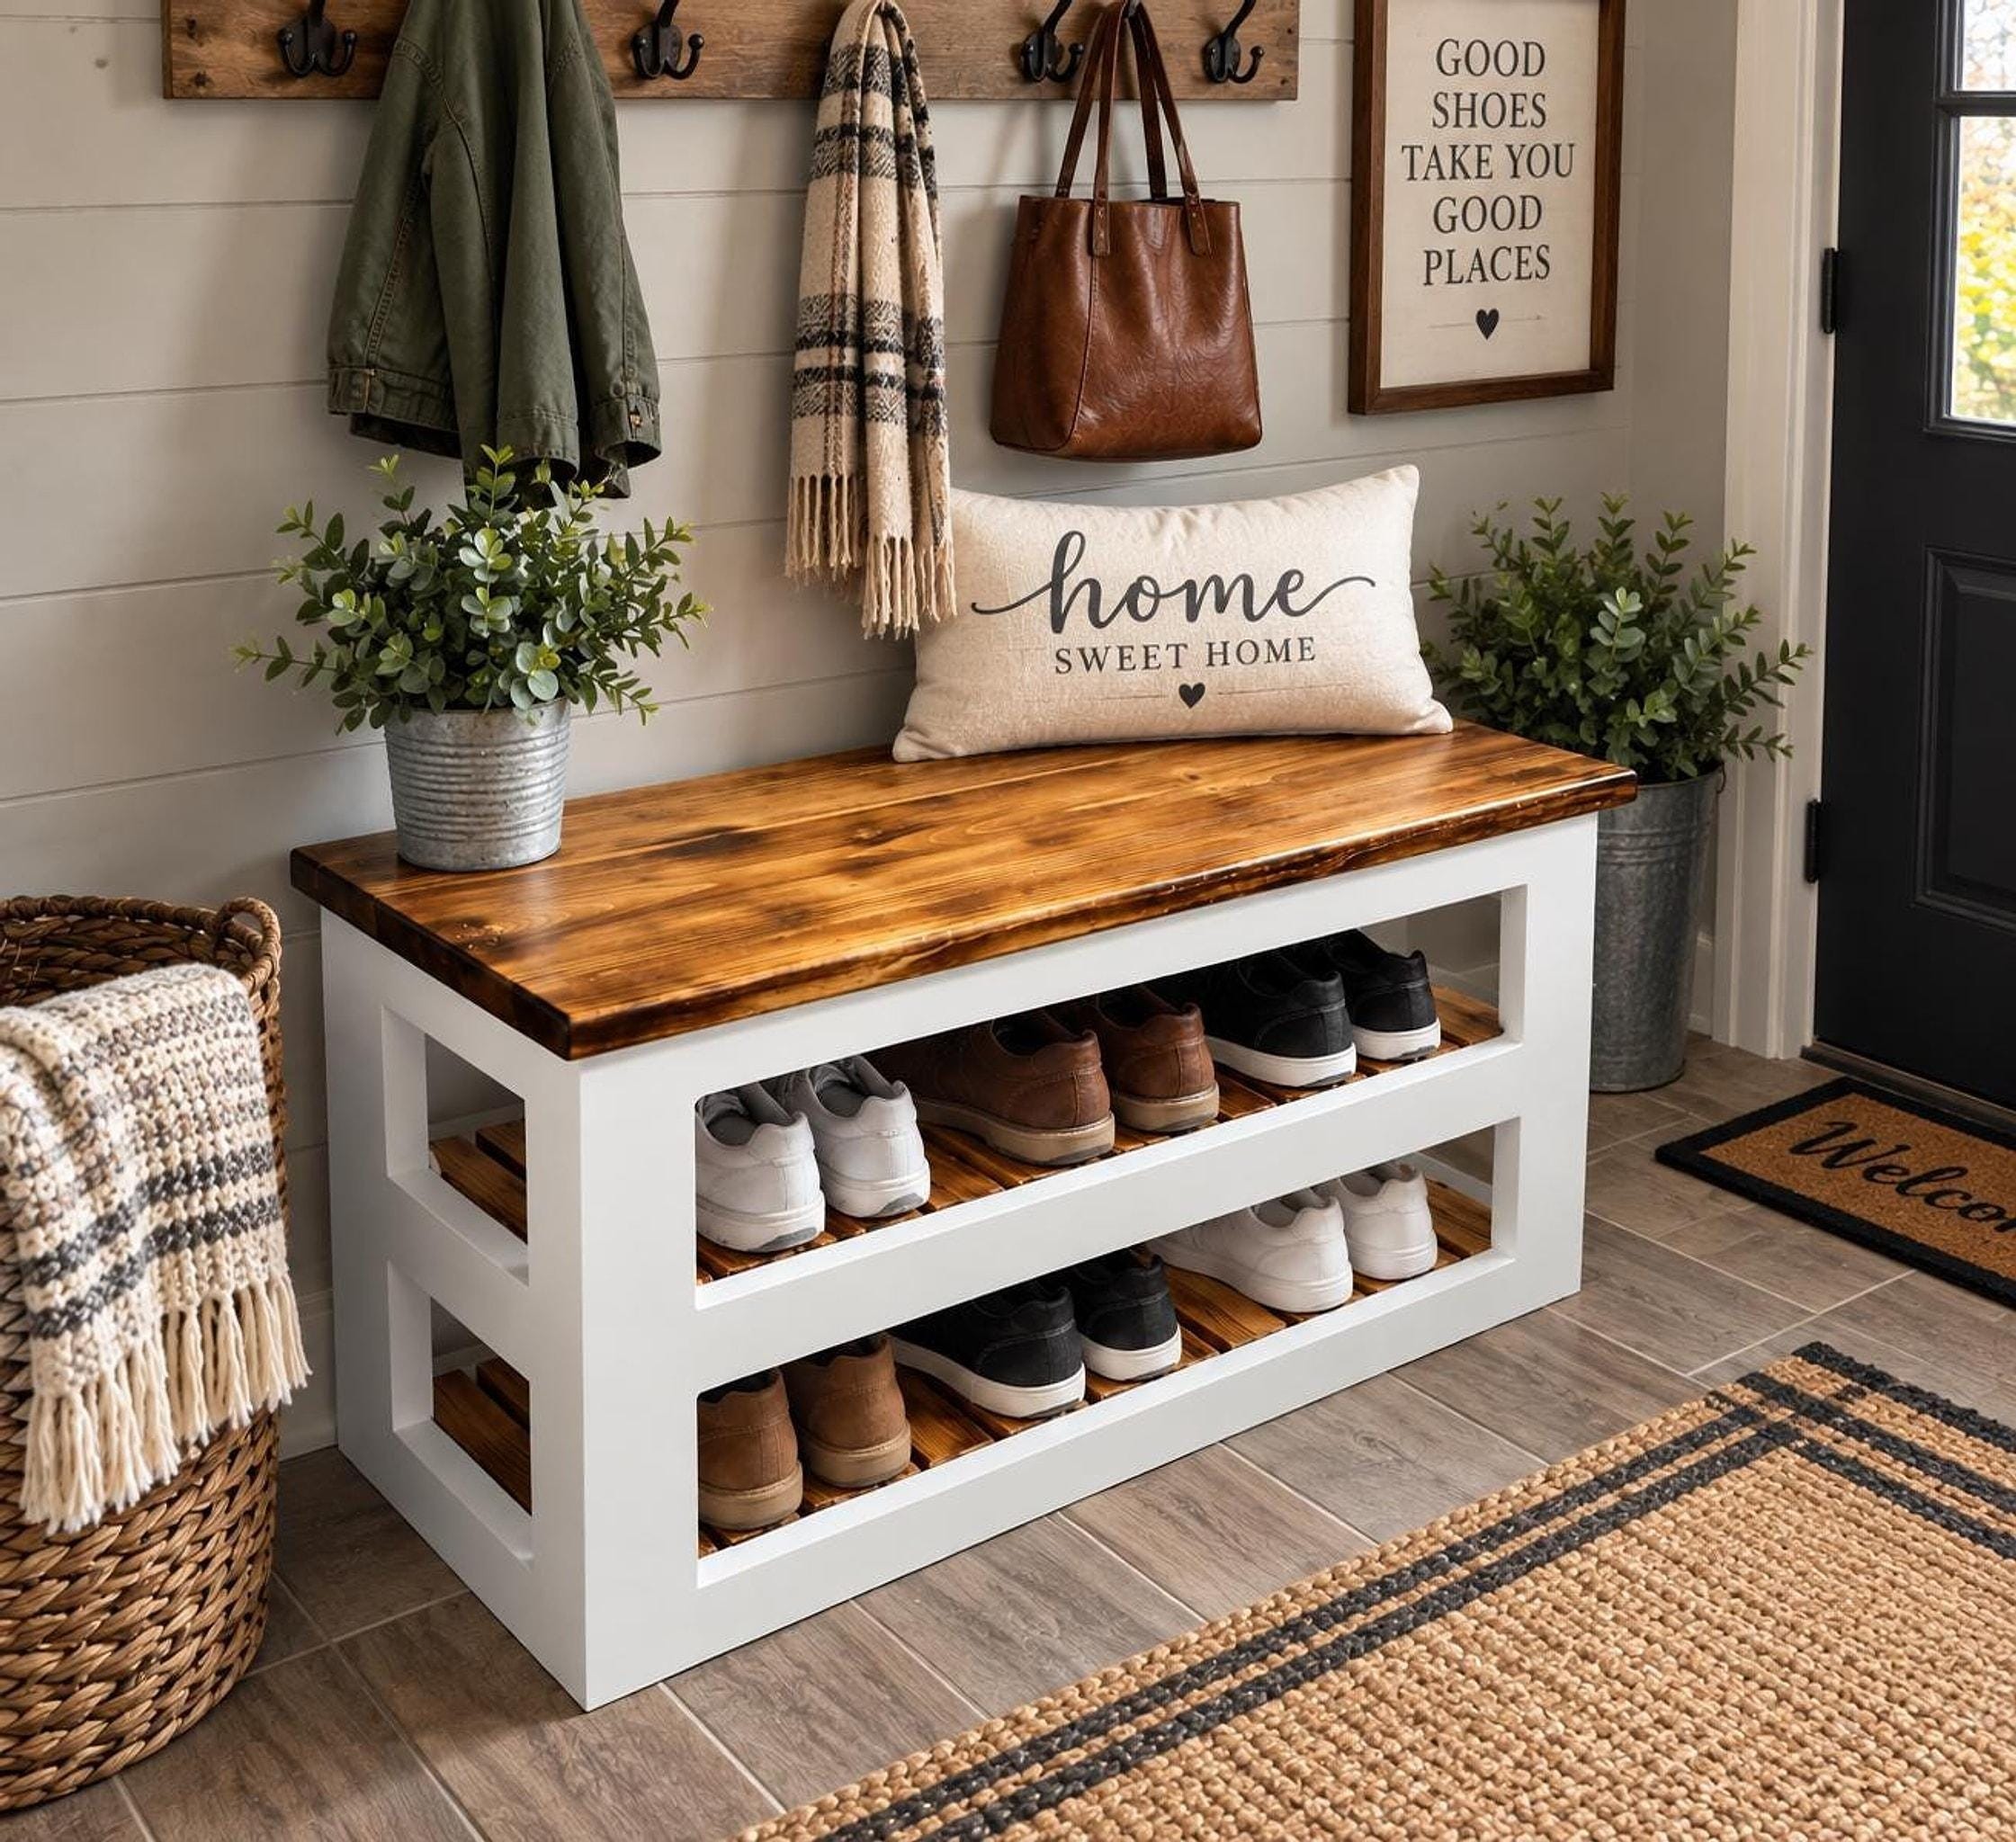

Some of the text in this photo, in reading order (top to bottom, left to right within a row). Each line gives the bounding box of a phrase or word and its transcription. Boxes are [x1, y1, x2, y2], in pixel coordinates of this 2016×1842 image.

[1436, 38, 1546, 76] GOOD
[1432, 92, 1546, 129] SHOES
[1401, 143, 1575, 181] TAKE YOU
[1433, 194, 1542, 234] GOOD
[1423, 244, 1551, 286] PLACES
[972, 530, 1376, 634] home
[1054, 636, 1316, 675] SWEET HOME
